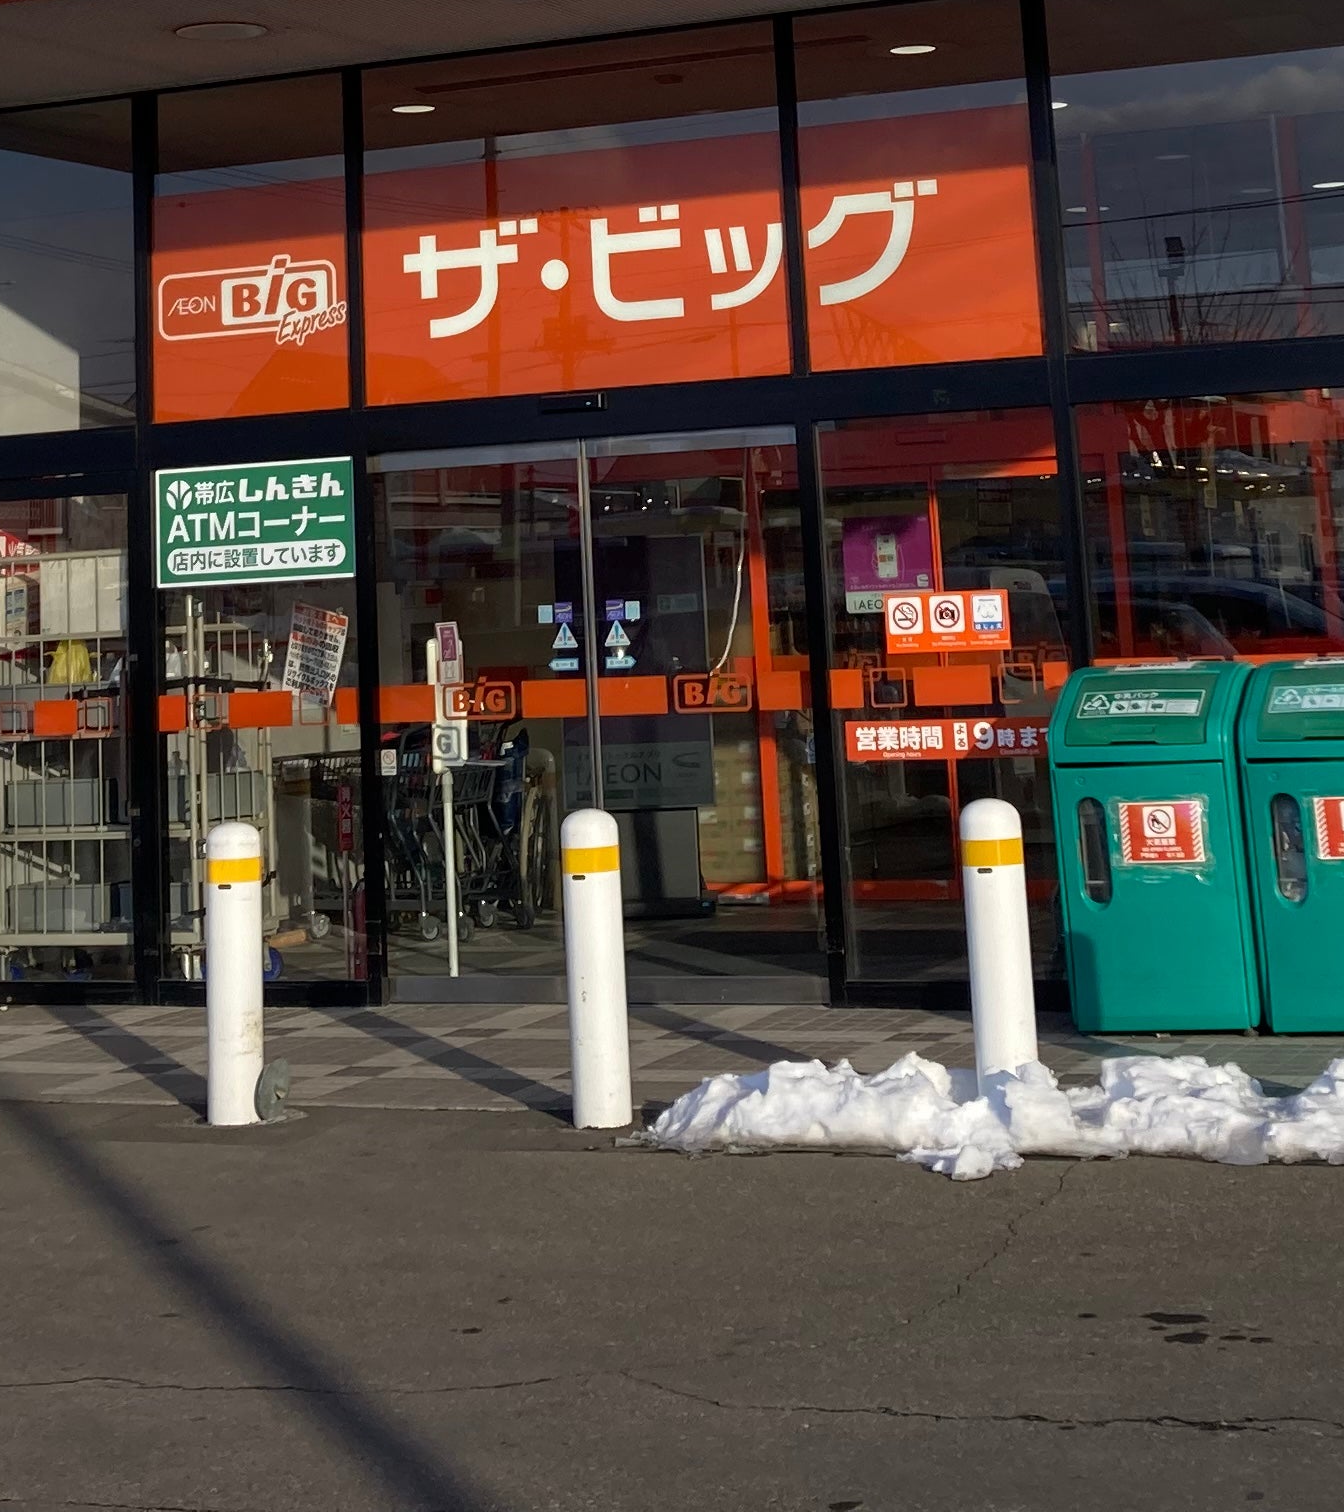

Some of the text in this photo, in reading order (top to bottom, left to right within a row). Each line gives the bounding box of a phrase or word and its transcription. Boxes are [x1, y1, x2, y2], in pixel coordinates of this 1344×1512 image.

[403, 179, 938, 338] ザ・ビッグ
[279, 303, 346, 343] Express
[194, 472, 345, 505] 帯広しんきん
[167, 505, 346, 544] ATMコーナー
[172, 543, 341, 572] 店内に設置しています
[856, 725, 943, 751] 営業時間
[956, 724, 966, 748] よる
